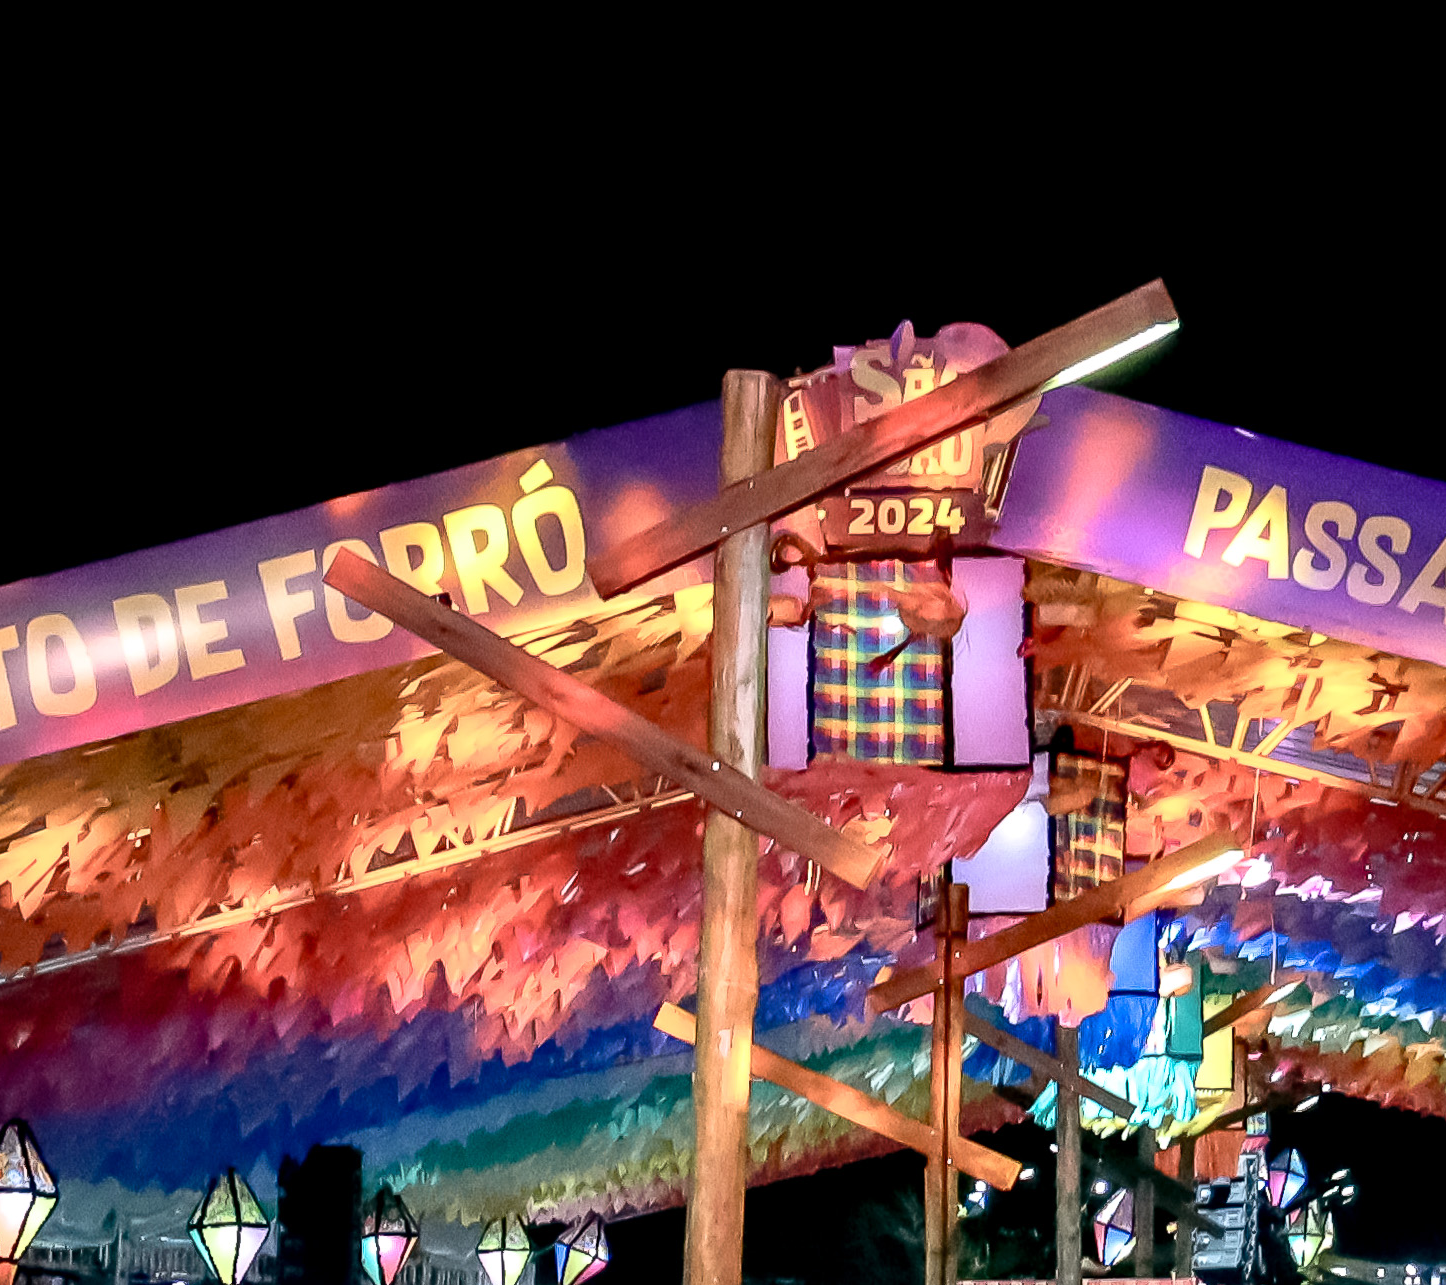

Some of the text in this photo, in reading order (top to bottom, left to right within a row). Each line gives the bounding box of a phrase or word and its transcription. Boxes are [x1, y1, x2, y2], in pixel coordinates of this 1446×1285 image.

[112, 579, 245, 698] DE
[257, 457, 588, 664] FORRÓ
[848, 497, 966, 536] 2024
